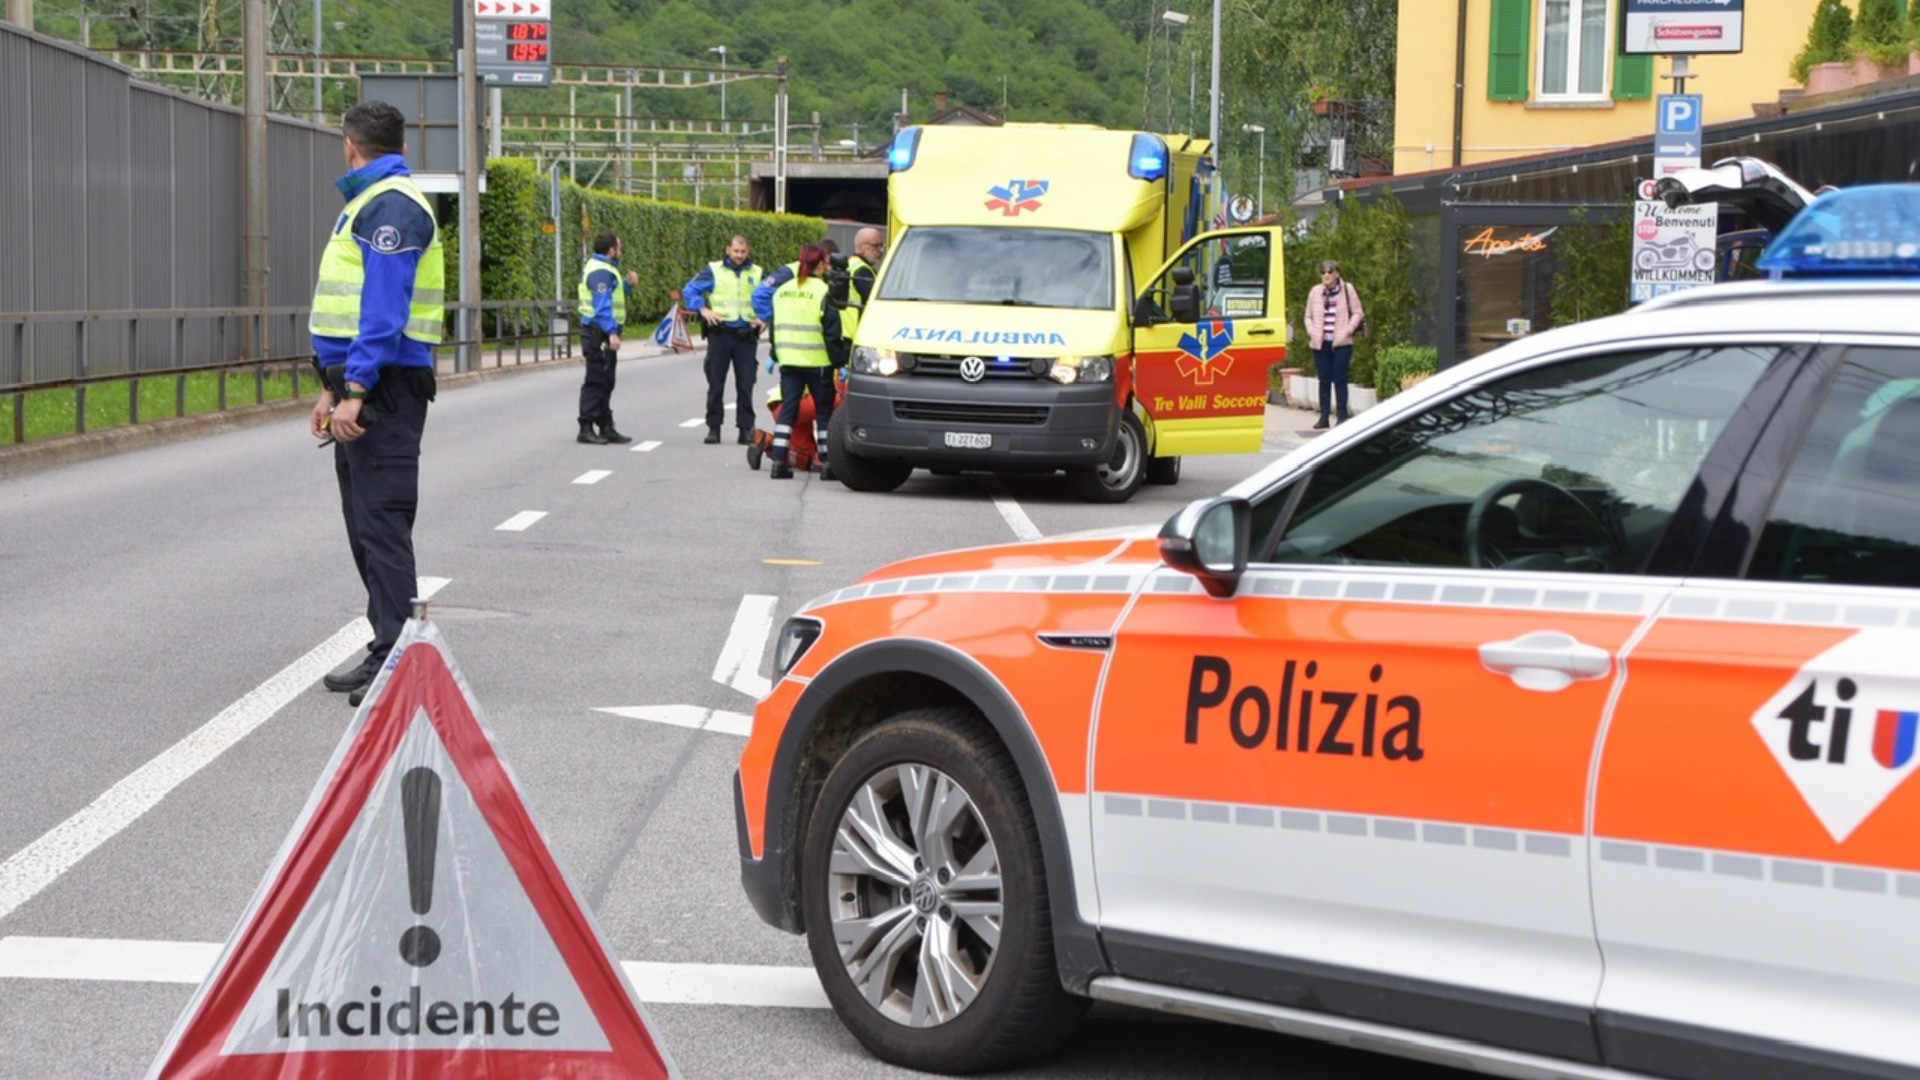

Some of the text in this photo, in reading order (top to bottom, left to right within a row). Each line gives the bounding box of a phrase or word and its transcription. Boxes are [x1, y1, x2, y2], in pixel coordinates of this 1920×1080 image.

[1667, 101, 1692, 130] P
[1655, 216, 1715, 228] Benvenuti
[1463, 227, 1547, 259] Aperto
[1634, 269, 1713, 281] WILLKOMMEN
[1154, 396, 1174, 411] Tre
[1178, 395, 1207, 410] Valli
[1185, 655, 1424, 762] Polizia
[1776, 677, 1857, 765] ti
[276, 986, 561, 1038] Incidente
